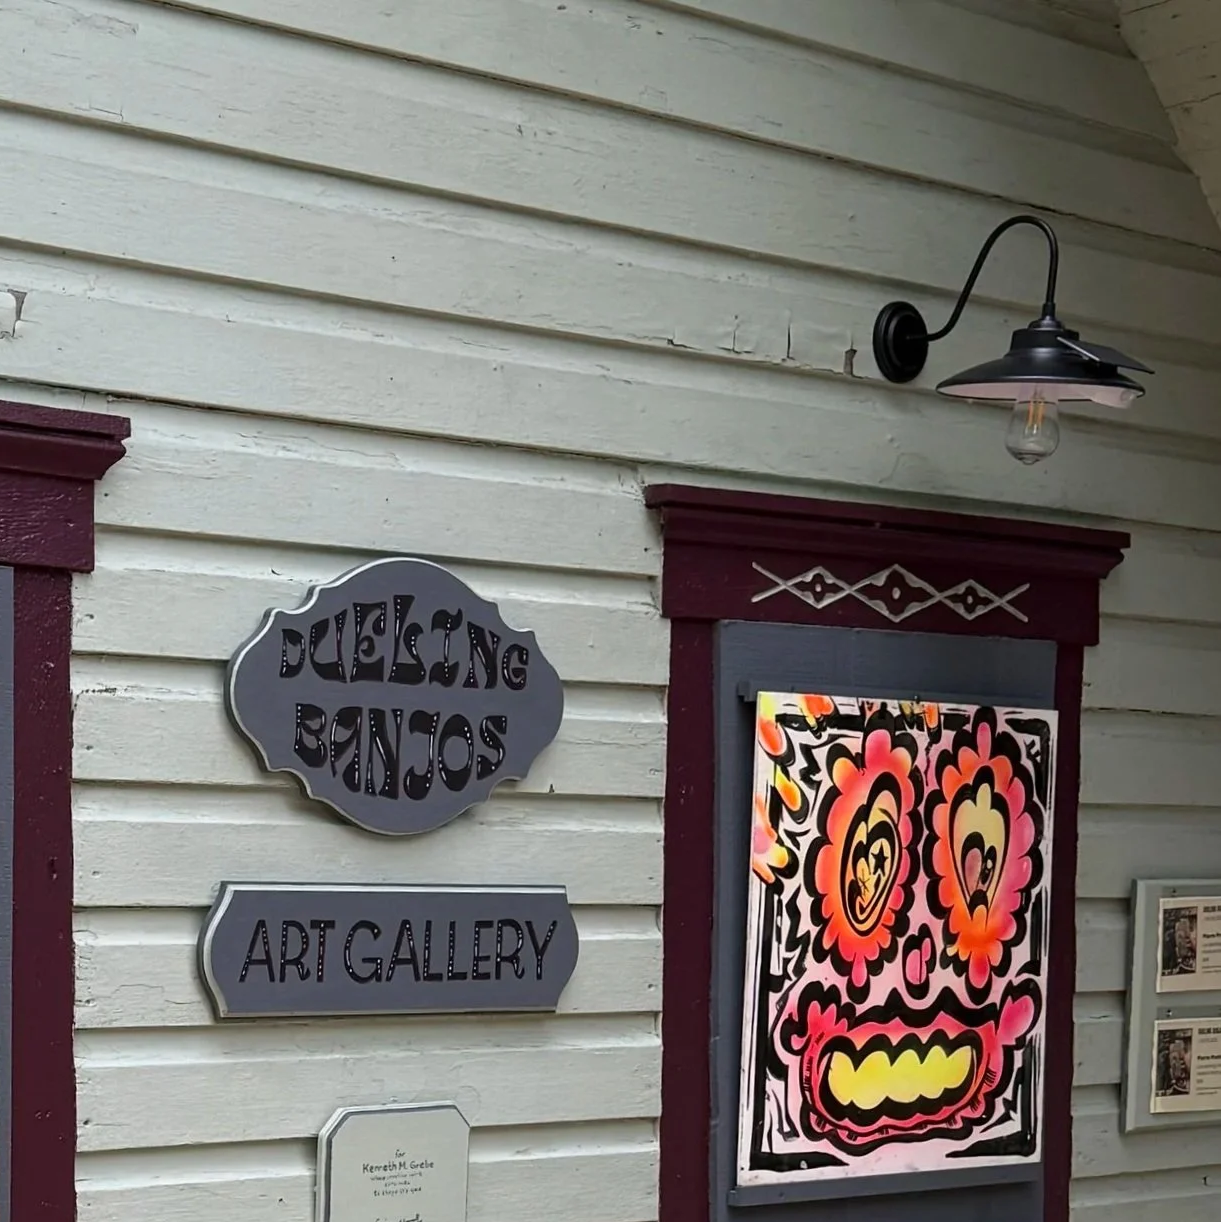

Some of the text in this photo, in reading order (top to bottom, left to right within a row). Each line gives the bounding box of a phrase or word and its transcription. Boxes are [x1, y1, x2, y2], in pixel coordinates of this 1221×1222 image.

[279, 594, 529, 691] DUELING
[293, 702, 508, 801] BANJOS
[238, 917, 559, 985] ART GALLERY
